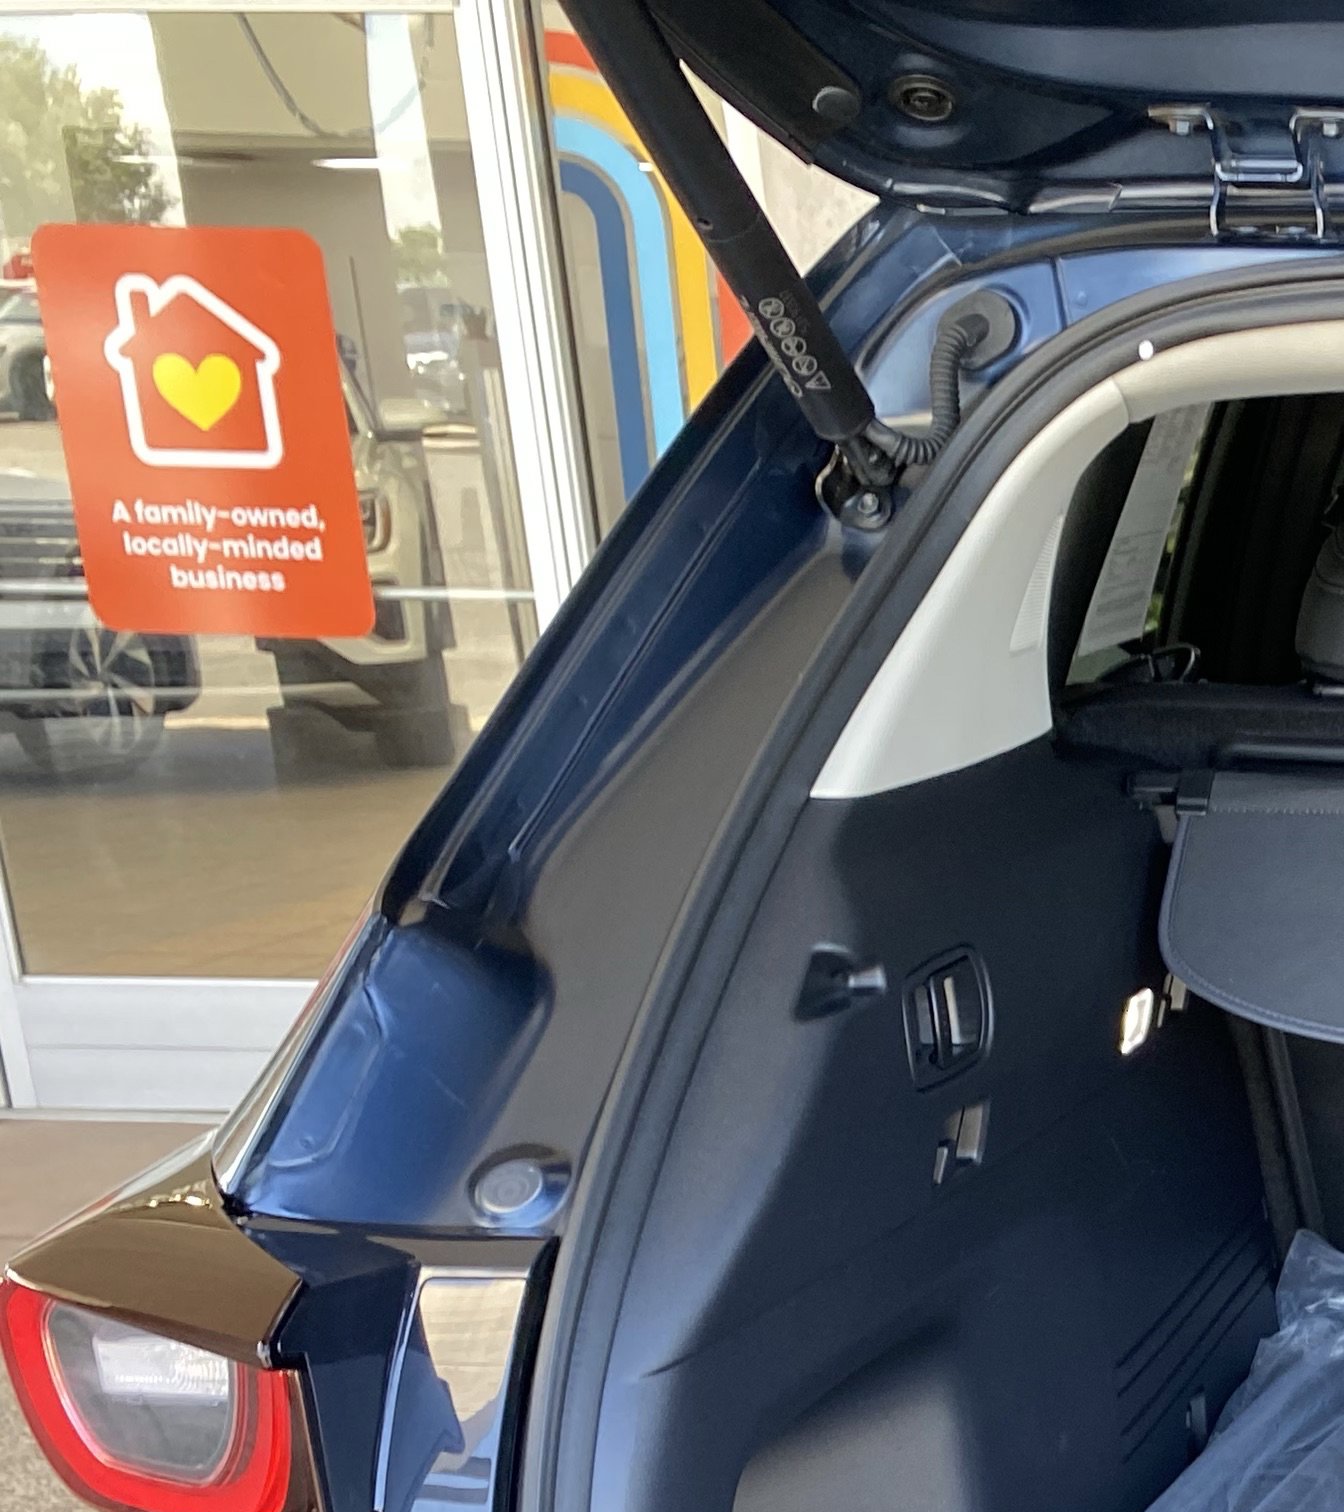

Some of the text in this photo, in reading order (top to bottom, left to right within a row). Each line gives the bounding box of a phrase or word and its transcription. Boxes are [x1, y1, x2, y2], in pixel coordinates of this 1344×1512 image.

[112, 498, 326, 533] A family-owned,
[122, 530, 323, 564] locally-minded
[169, 563, 286, 593] business
